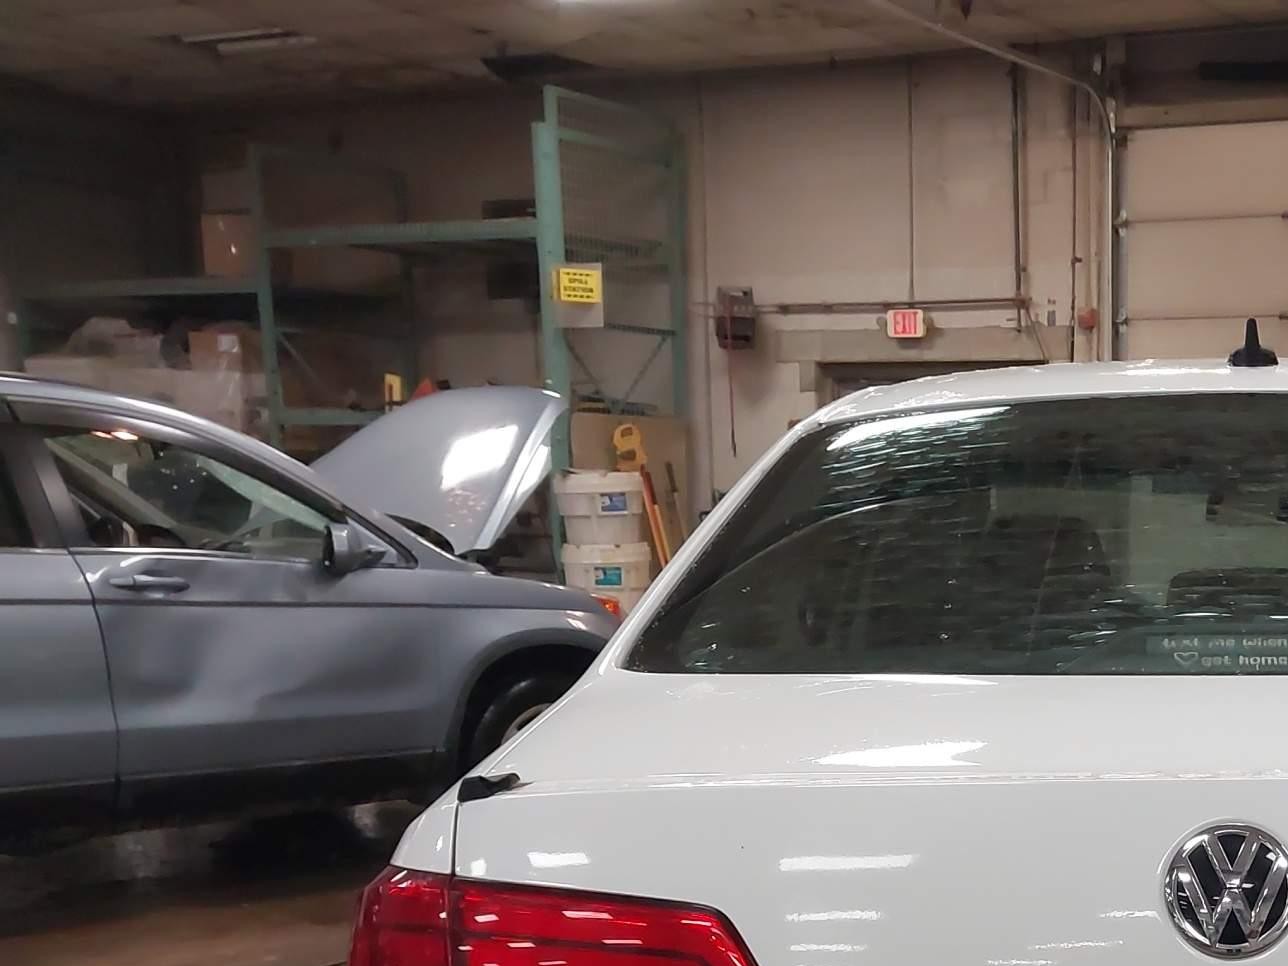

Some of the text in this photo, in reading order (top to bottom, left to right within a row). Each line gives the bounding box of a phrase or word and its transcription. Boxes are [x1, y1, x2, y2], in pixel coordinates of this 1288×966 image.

[893, 311, 919, 336] EXIT
[1201, 655, 1288, 667] get home
